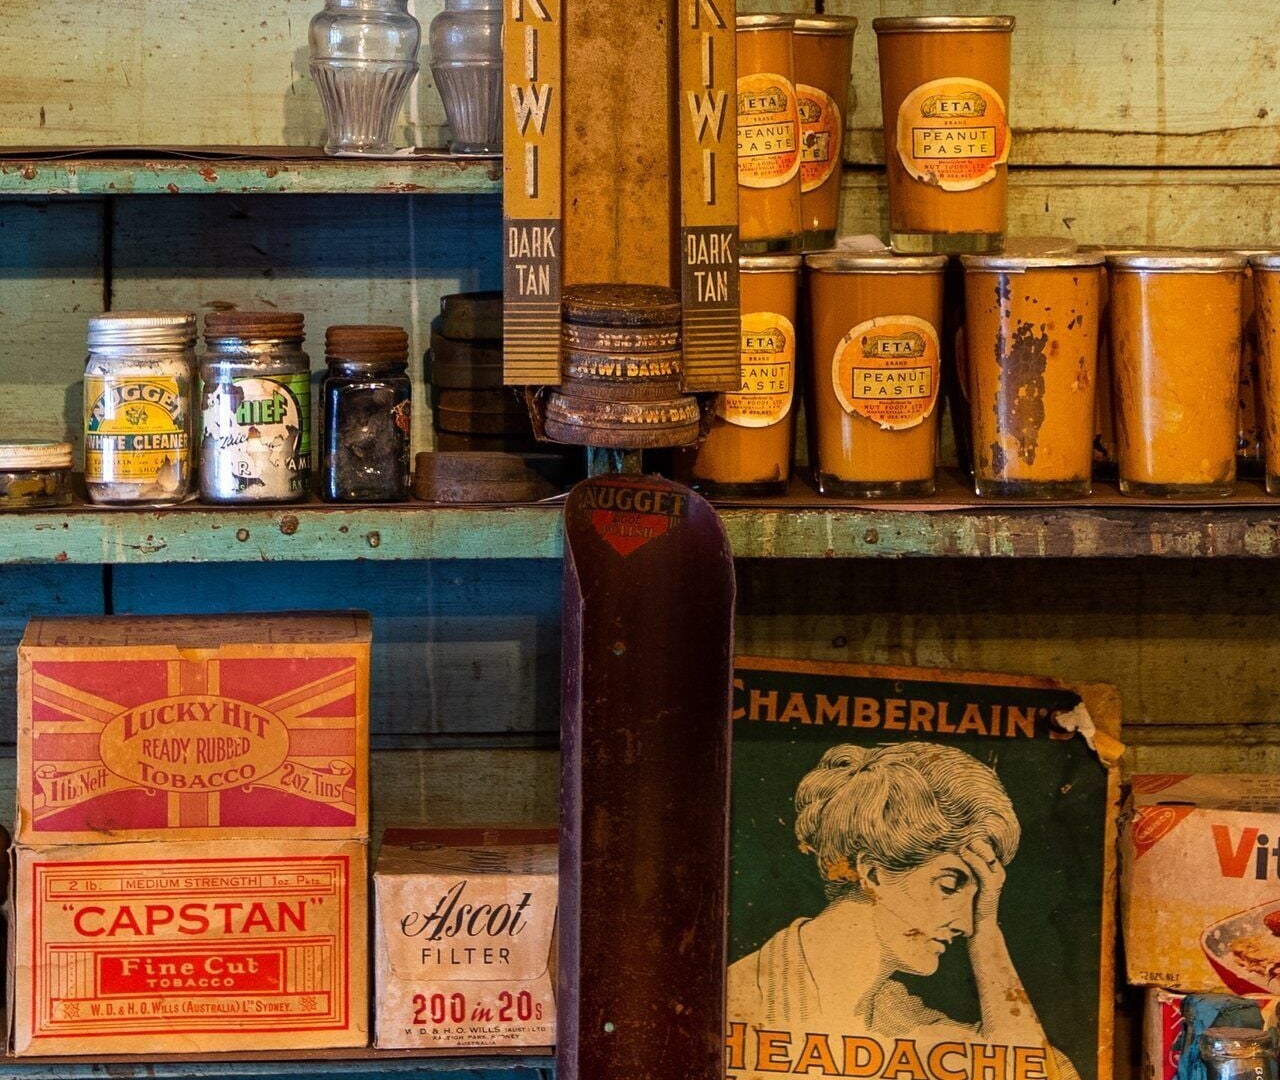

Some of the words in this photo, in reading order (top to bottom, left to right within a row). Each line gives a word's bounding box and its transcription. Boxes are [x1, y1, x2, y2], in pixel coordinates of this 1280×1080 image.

[940, 101, 972, 113] ETA
[922, 129, 989, 142] PEANUT
[922, 143, 990, 154] PASTE
[508, 225, 556, 258] DARK
[686, 233, 733, 265] DARK
[515, 263, 551, 297] TAN
[694, 270, 728, 304] TAN
[133, 433, 188, 449] CLEANER
[581, 484, 686, 517] NUGGET
[122, 702, 219, 743] LUCKY
[222, 701, 272, 740] HIT
[142, 737, 191, 764] READY
[196, 737, 251, 764] RUBBED
[136, 762, 257, 790] TOBACCO
[125, 878, 184, 890] MEDIUM
[187, 876, 259, 889] STRENGTH
[400, 880, 532, 943] Ascot
[121, 957, 196, 977] Fine
[203, 956, 260, 975] Cut
[422, 948, 511, 965] FILTER
[146, 977, 235, 989] TOBACCO
[412, 992, 467, 1025] 200
[470, 1001, 495, 1021] in
